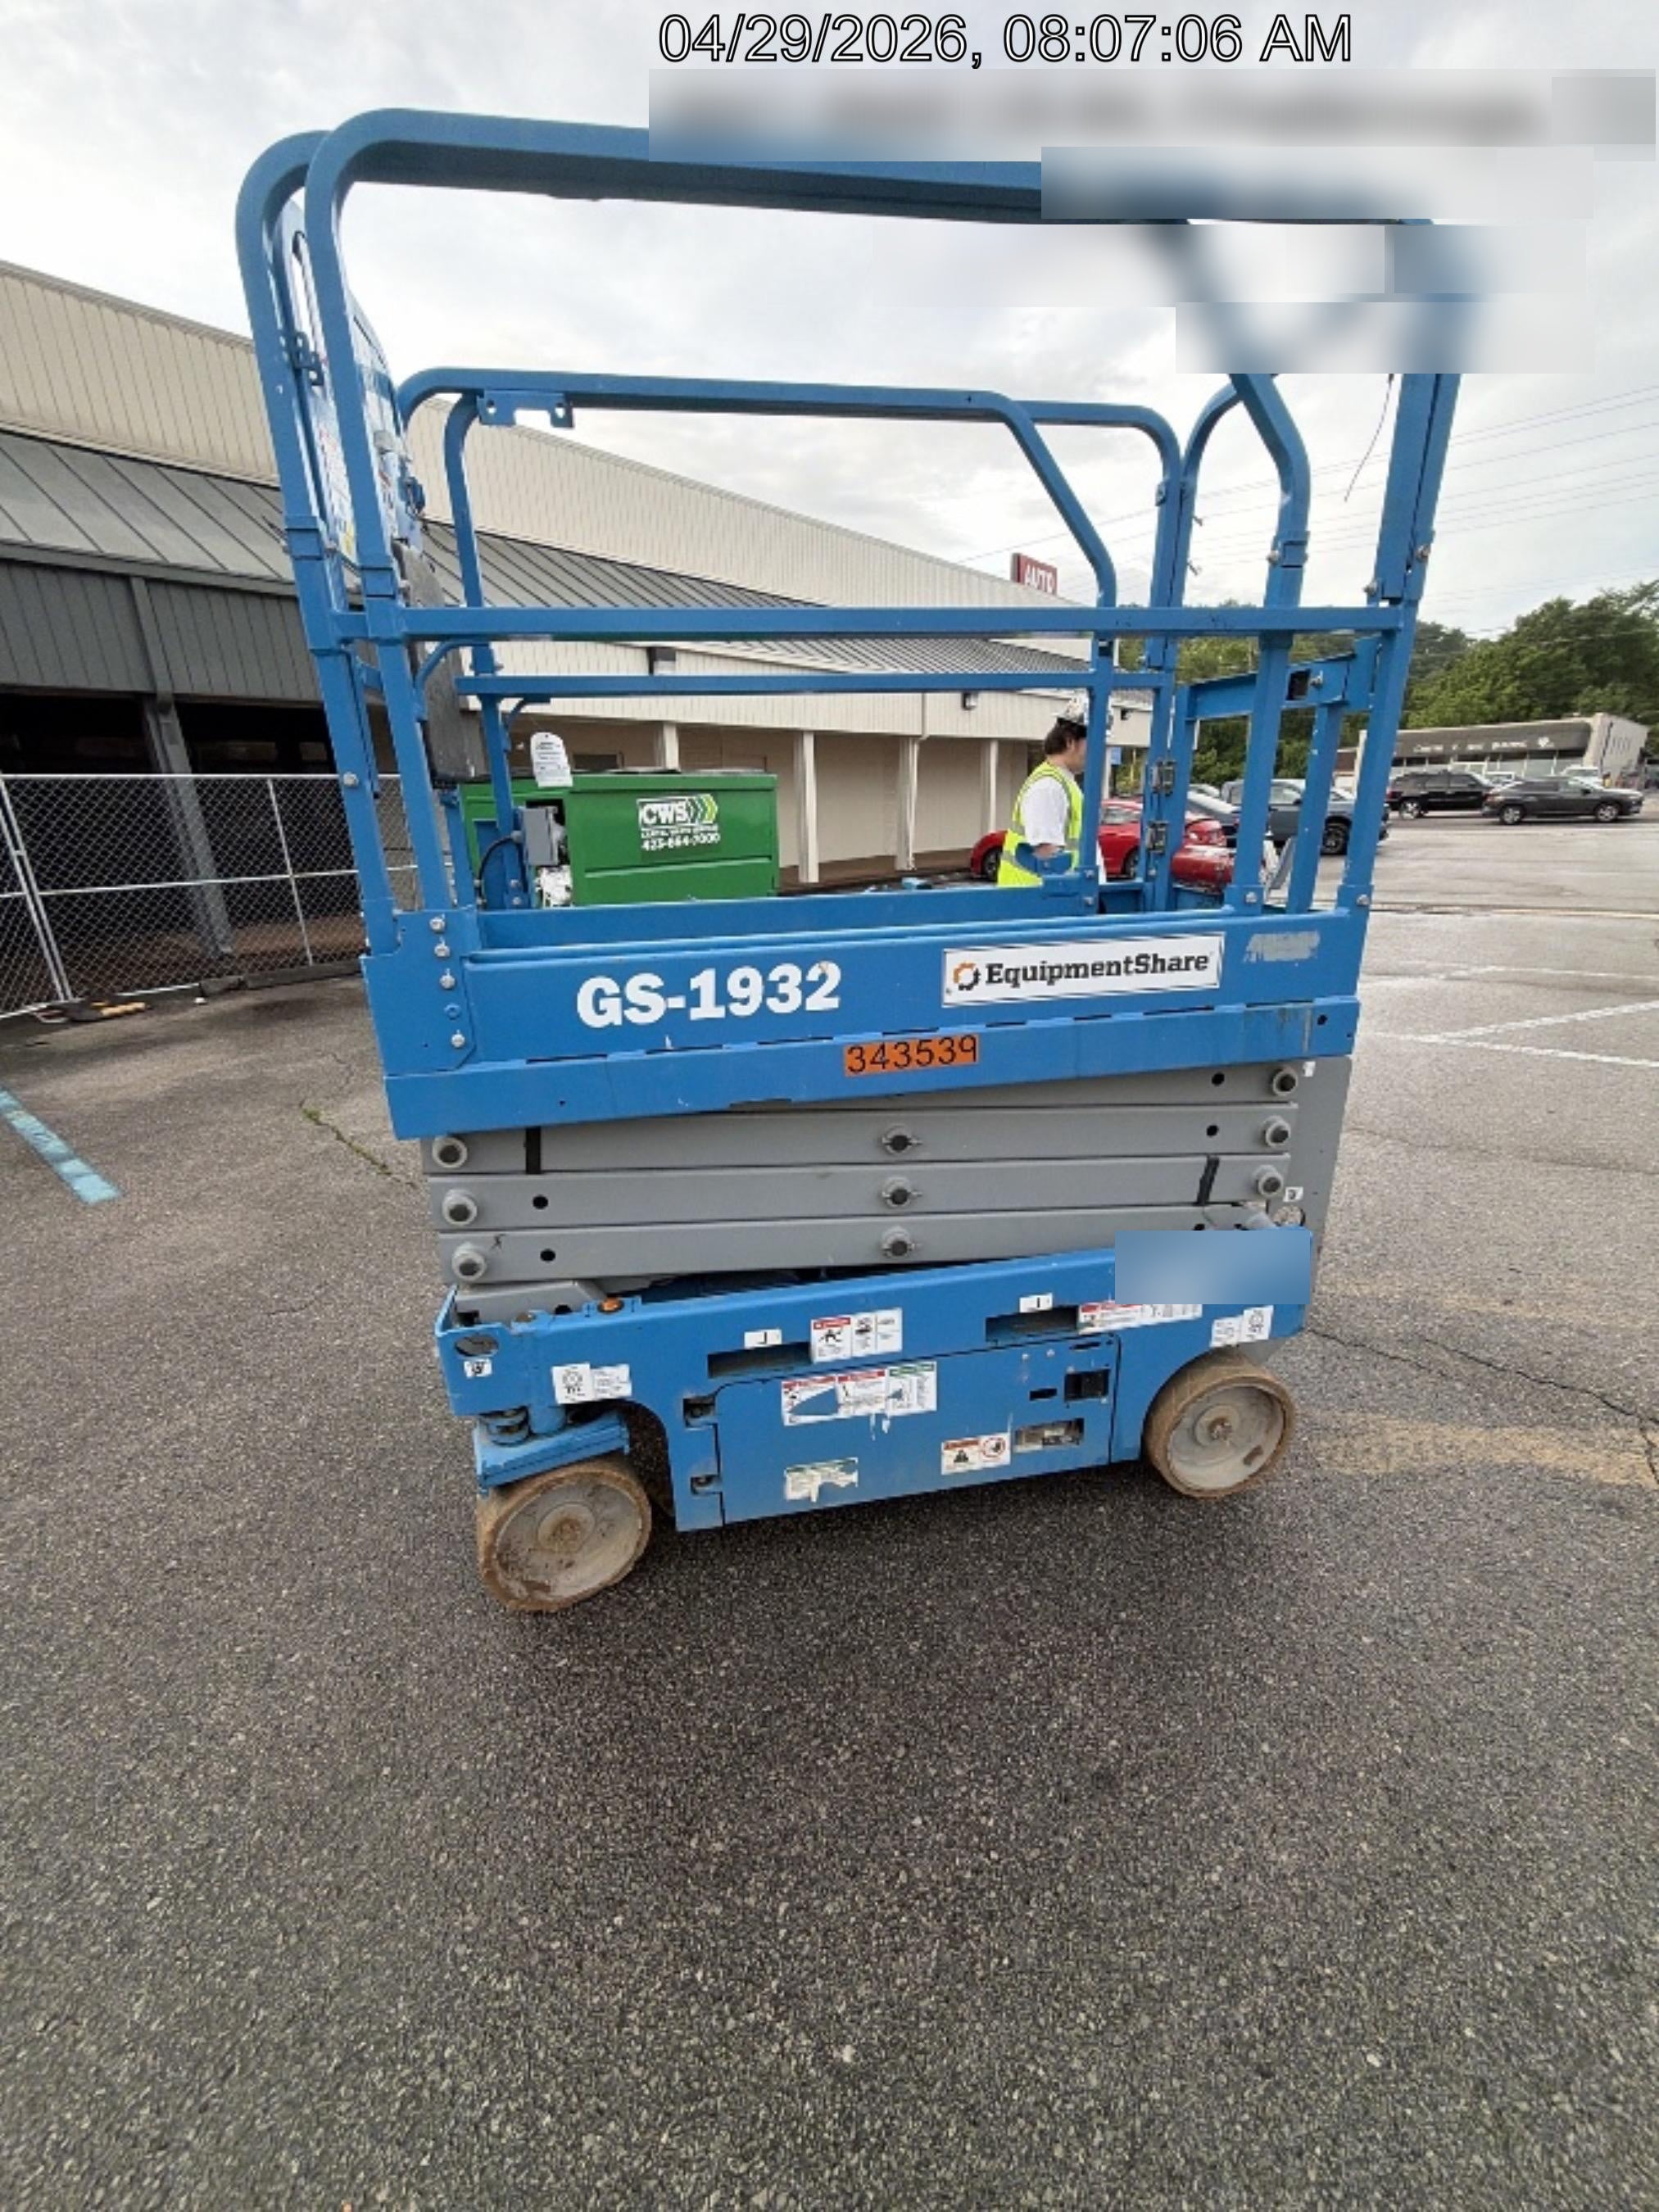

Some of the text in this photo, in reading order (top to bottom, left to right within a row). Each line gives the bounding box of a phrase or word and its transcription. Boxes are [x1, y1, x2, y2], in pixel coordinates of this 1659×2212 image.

[642, 800, 689, 824] CWS
[985, 951, 1209, 988] EquipmentShare
[577, 960, 841, 1028] GS-1932
[847, 1034, 977, 1074] 343539
